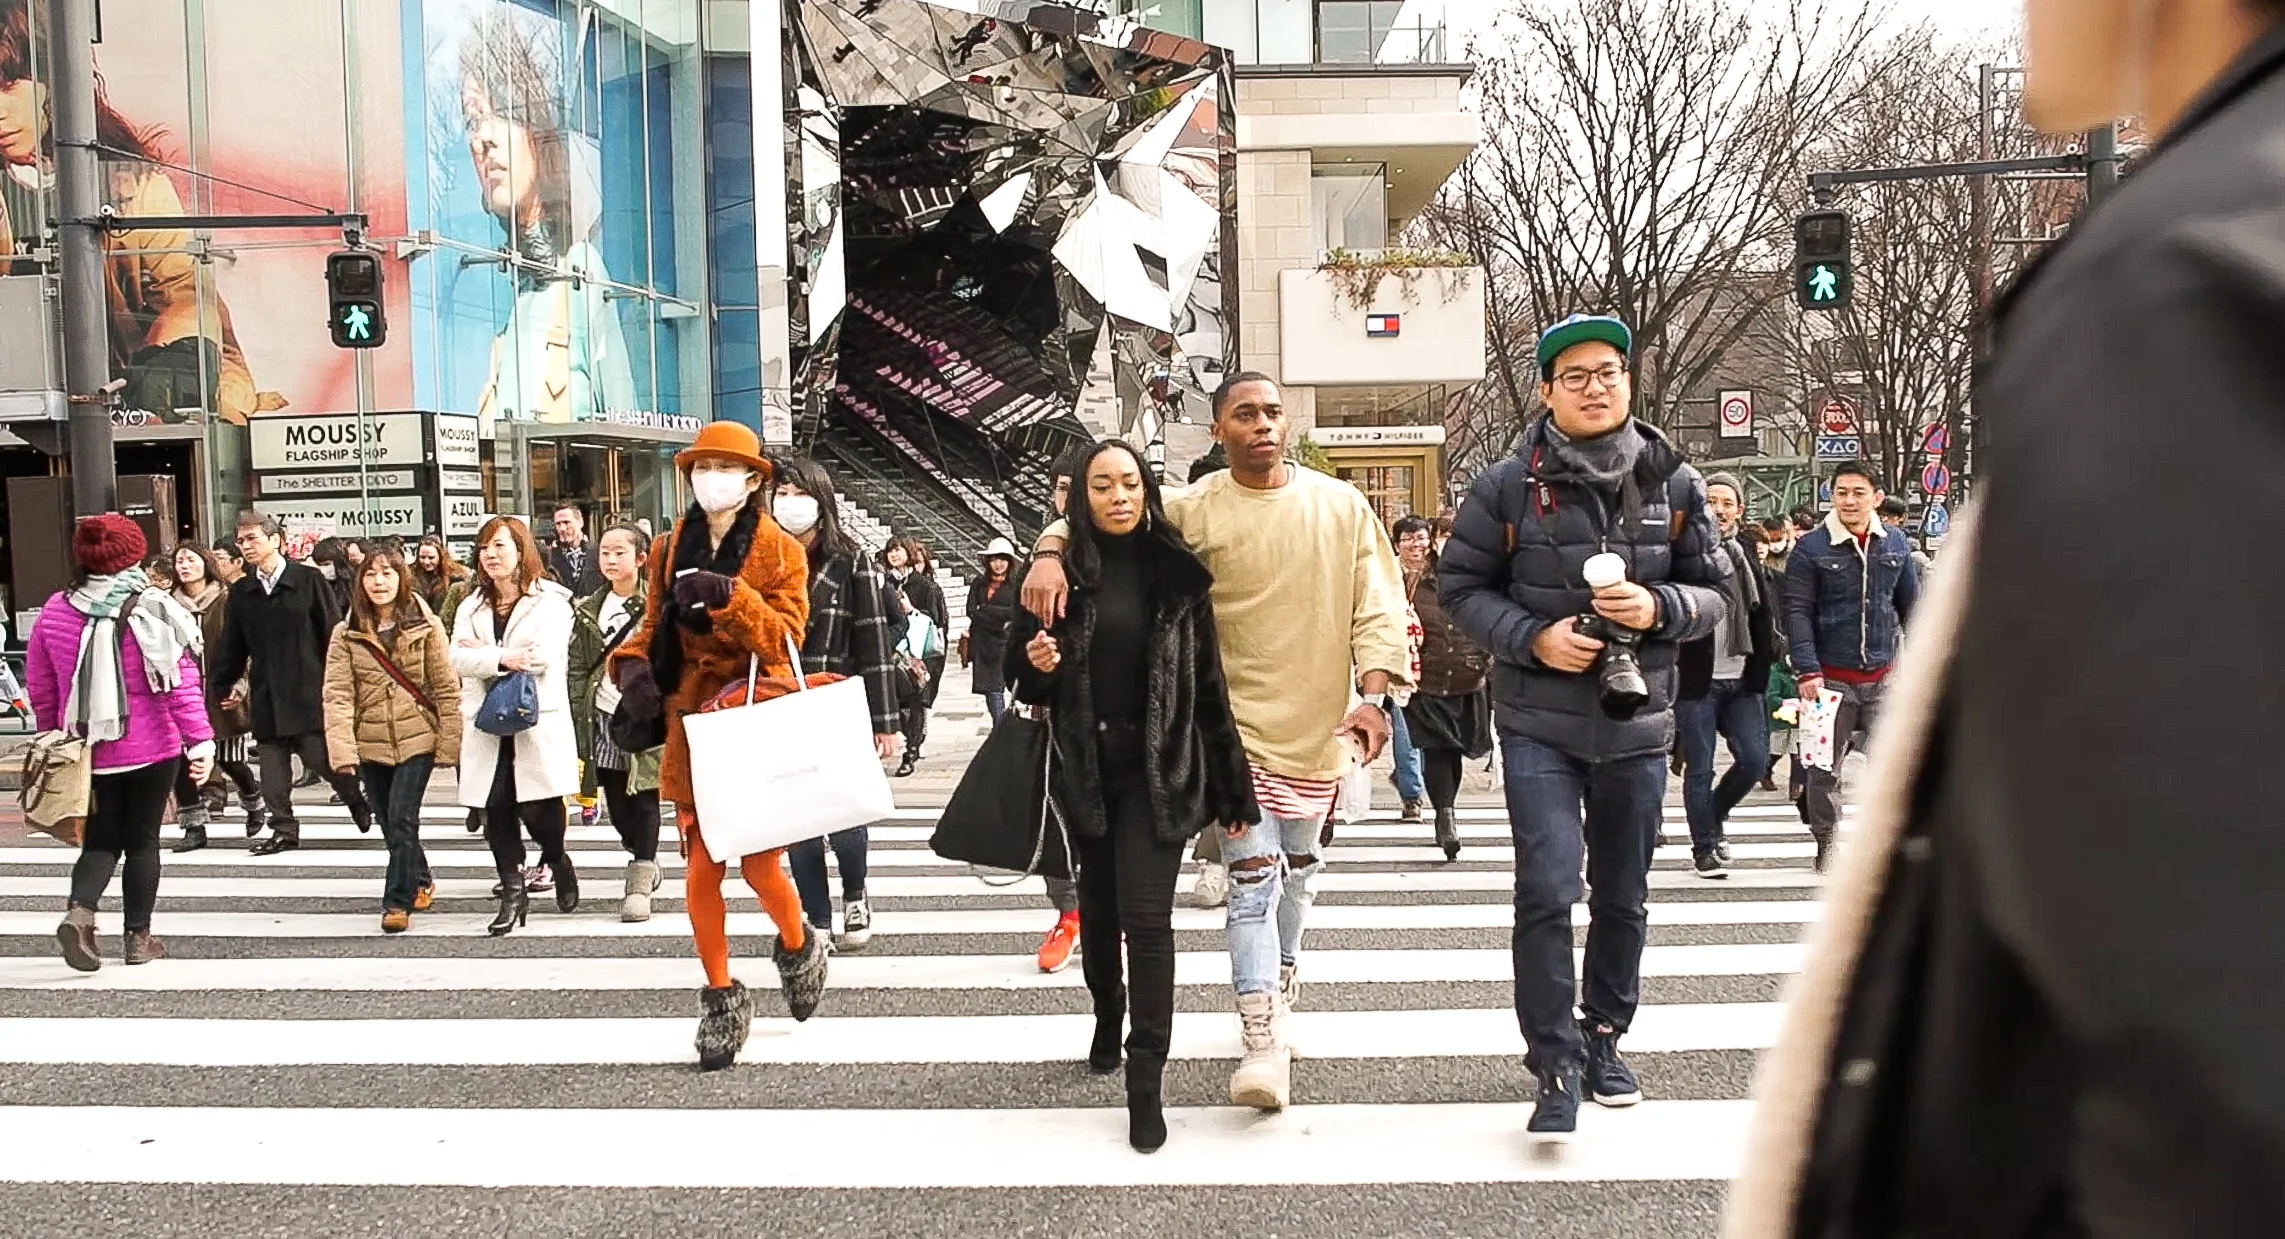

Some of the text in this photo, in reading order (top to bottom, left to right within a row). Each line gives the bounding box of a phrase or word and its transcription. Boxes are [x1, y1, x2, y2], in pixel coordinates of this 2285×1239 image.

[1728, 405, 1744, 418] 50
[285, 423, 386, 446] MOUSSY
[285, 448, 388, 462] FLAGSHIP SHOP
[451, 502, 479, 516] AZUL
[341, 509, 414, 527] MOUSSY
